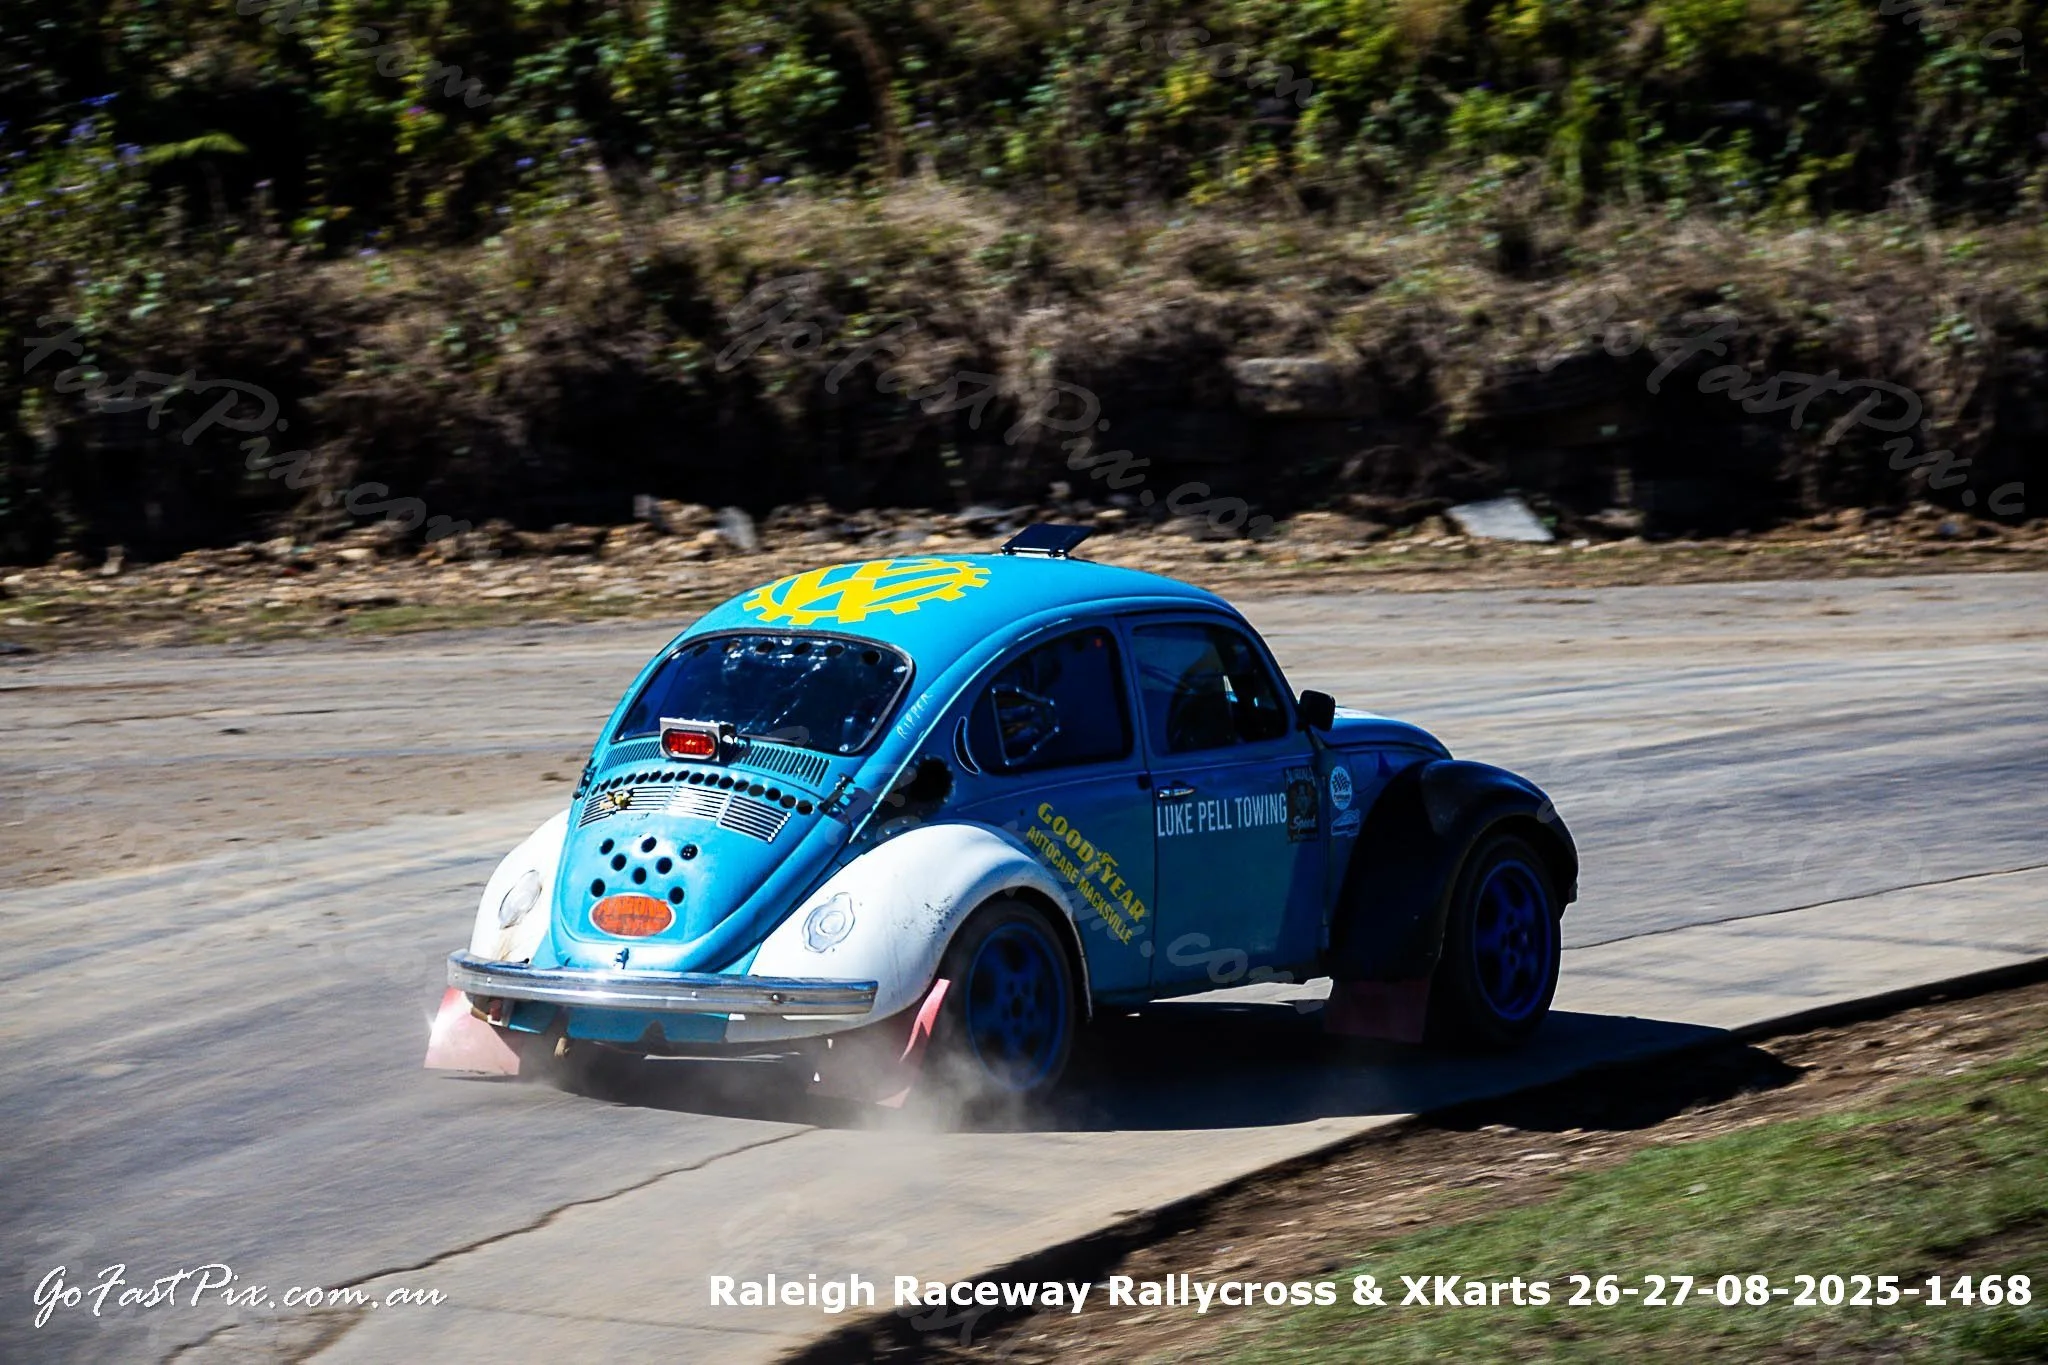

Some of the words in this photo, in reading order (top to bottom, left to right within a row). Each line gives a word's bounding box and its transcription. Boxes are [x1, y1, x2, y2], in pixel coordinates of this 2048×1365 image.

[1037, 803, 1146, 922] GOODYEAR
[1156, 803, 1194, 837] LUKE
[1198, 798, 1232, 832] PELL
[1234, 792, 1287, 828] TOWING
[1026, 826, 1080, 884] AUTOCARE
[1077, 876, 1133, 945] MACKSVILLE
